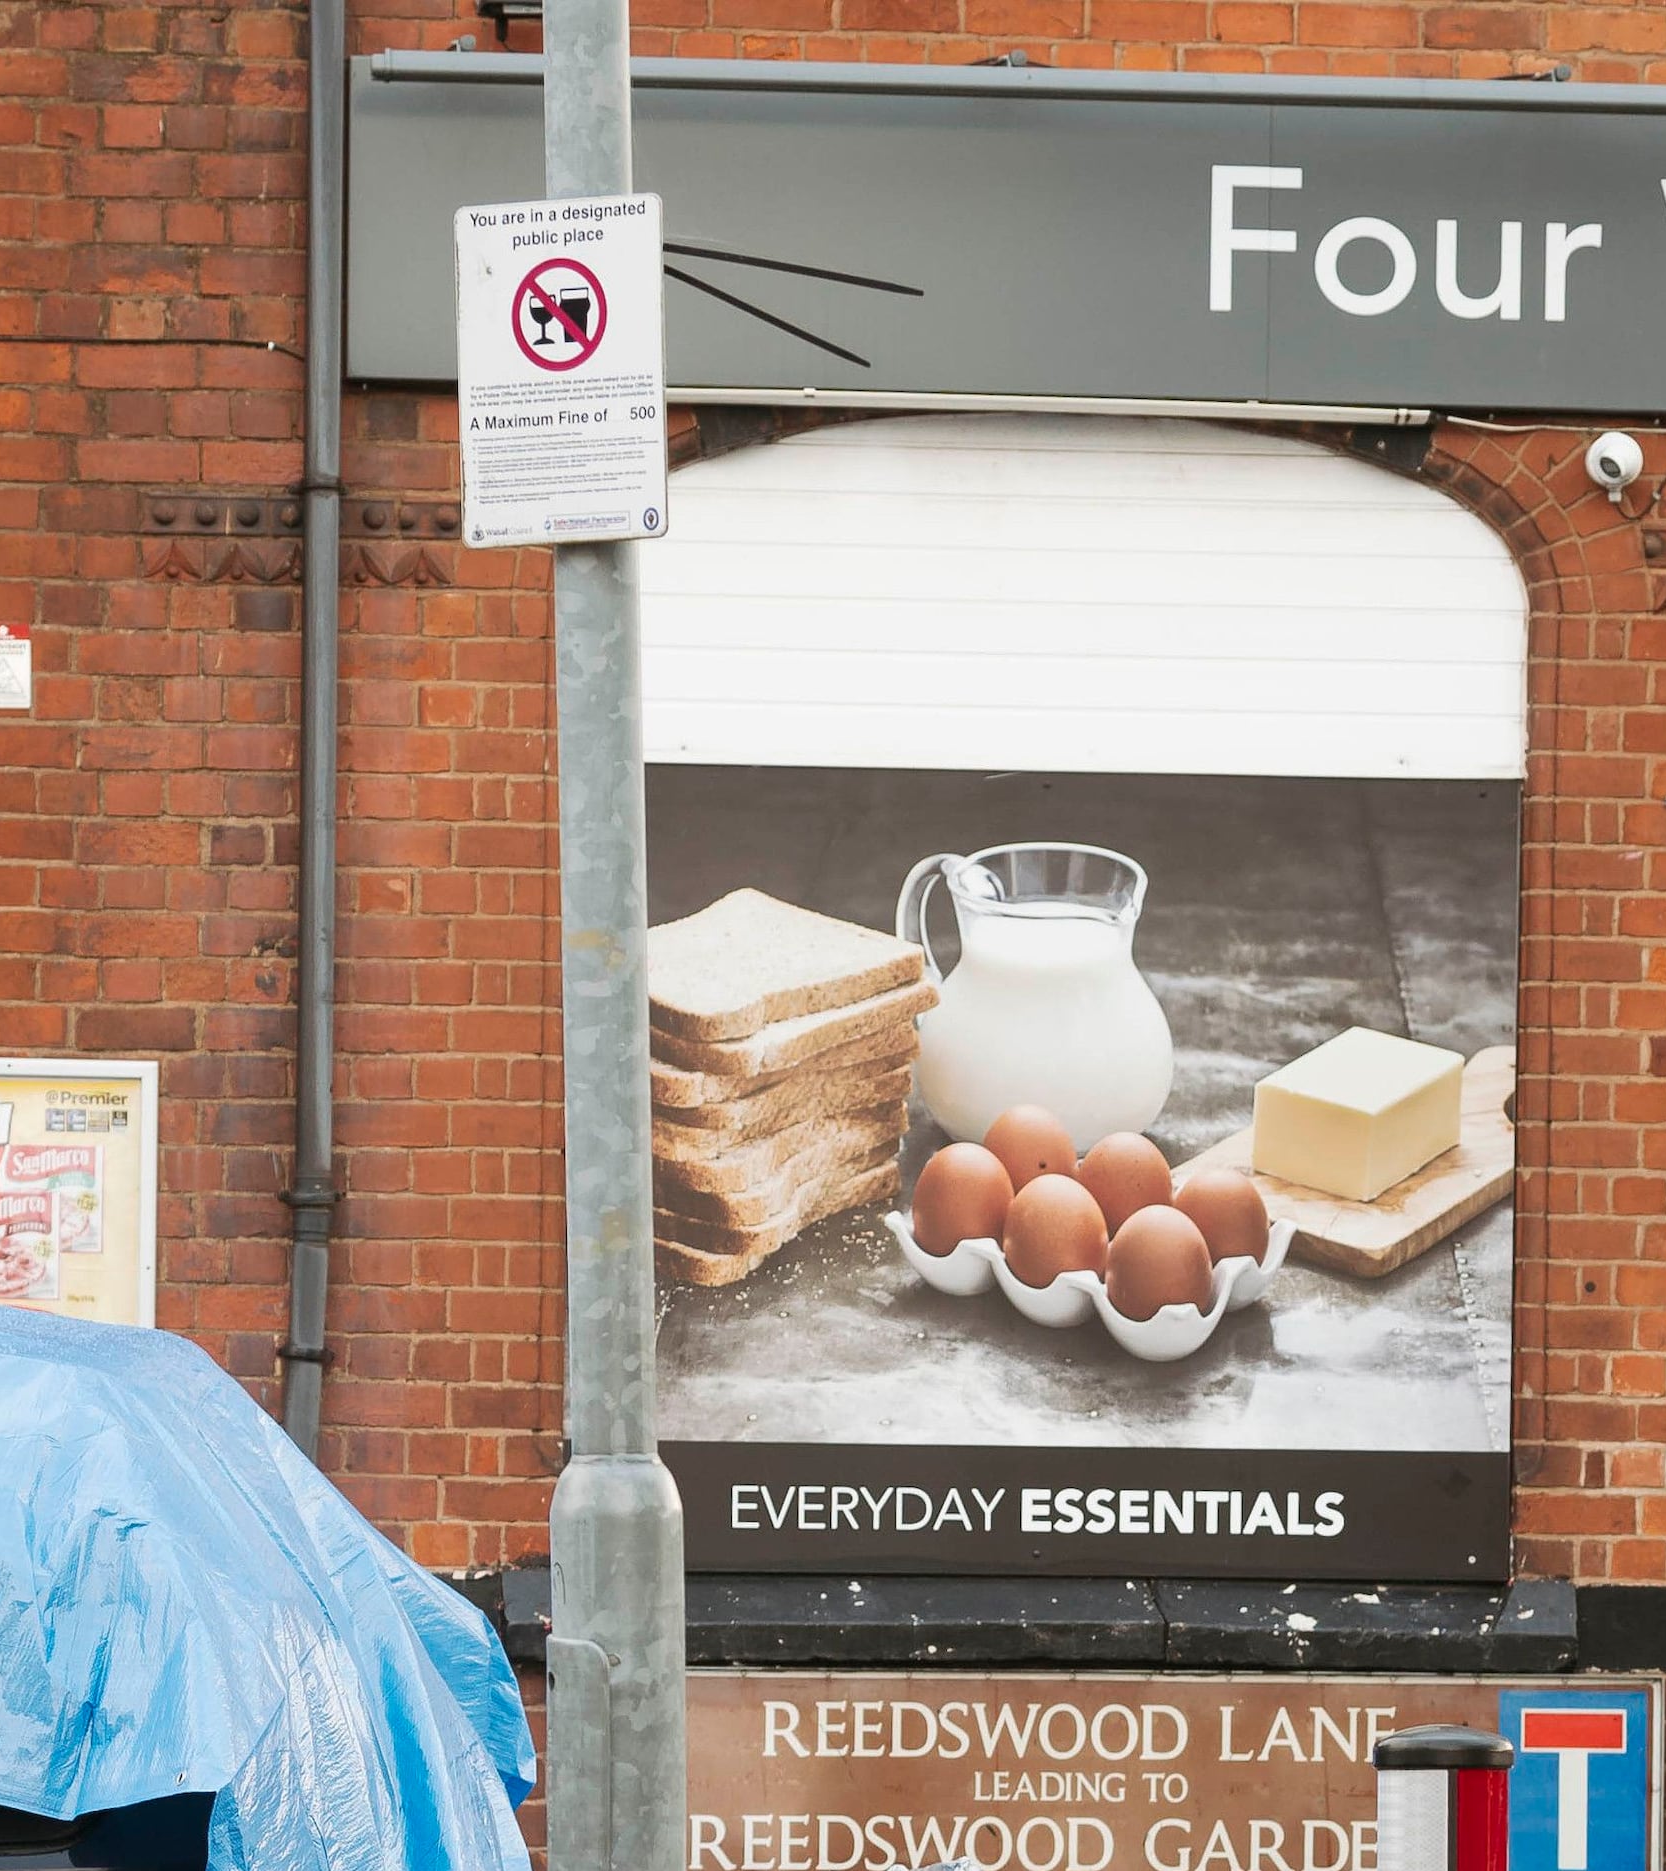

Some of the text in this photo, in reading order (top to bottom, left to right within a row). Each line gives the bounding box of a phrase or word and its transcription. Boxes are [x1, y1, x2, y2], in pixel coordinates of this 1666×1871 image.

[470, 201, 646, 228] You are in a designated
[512, 229, 604, 250] public place
[1209, 165, 1603, 316] Four
[470, 405, 656, 431] A Maximum Fine of 500
[731, 1484, 1345, 1537] EVERYDAY ESSENTIALS
[763, 1700, 1398, 1763] REEDSWOOD LANE
[974, 1769, 1188, 1804] LEADING TO
